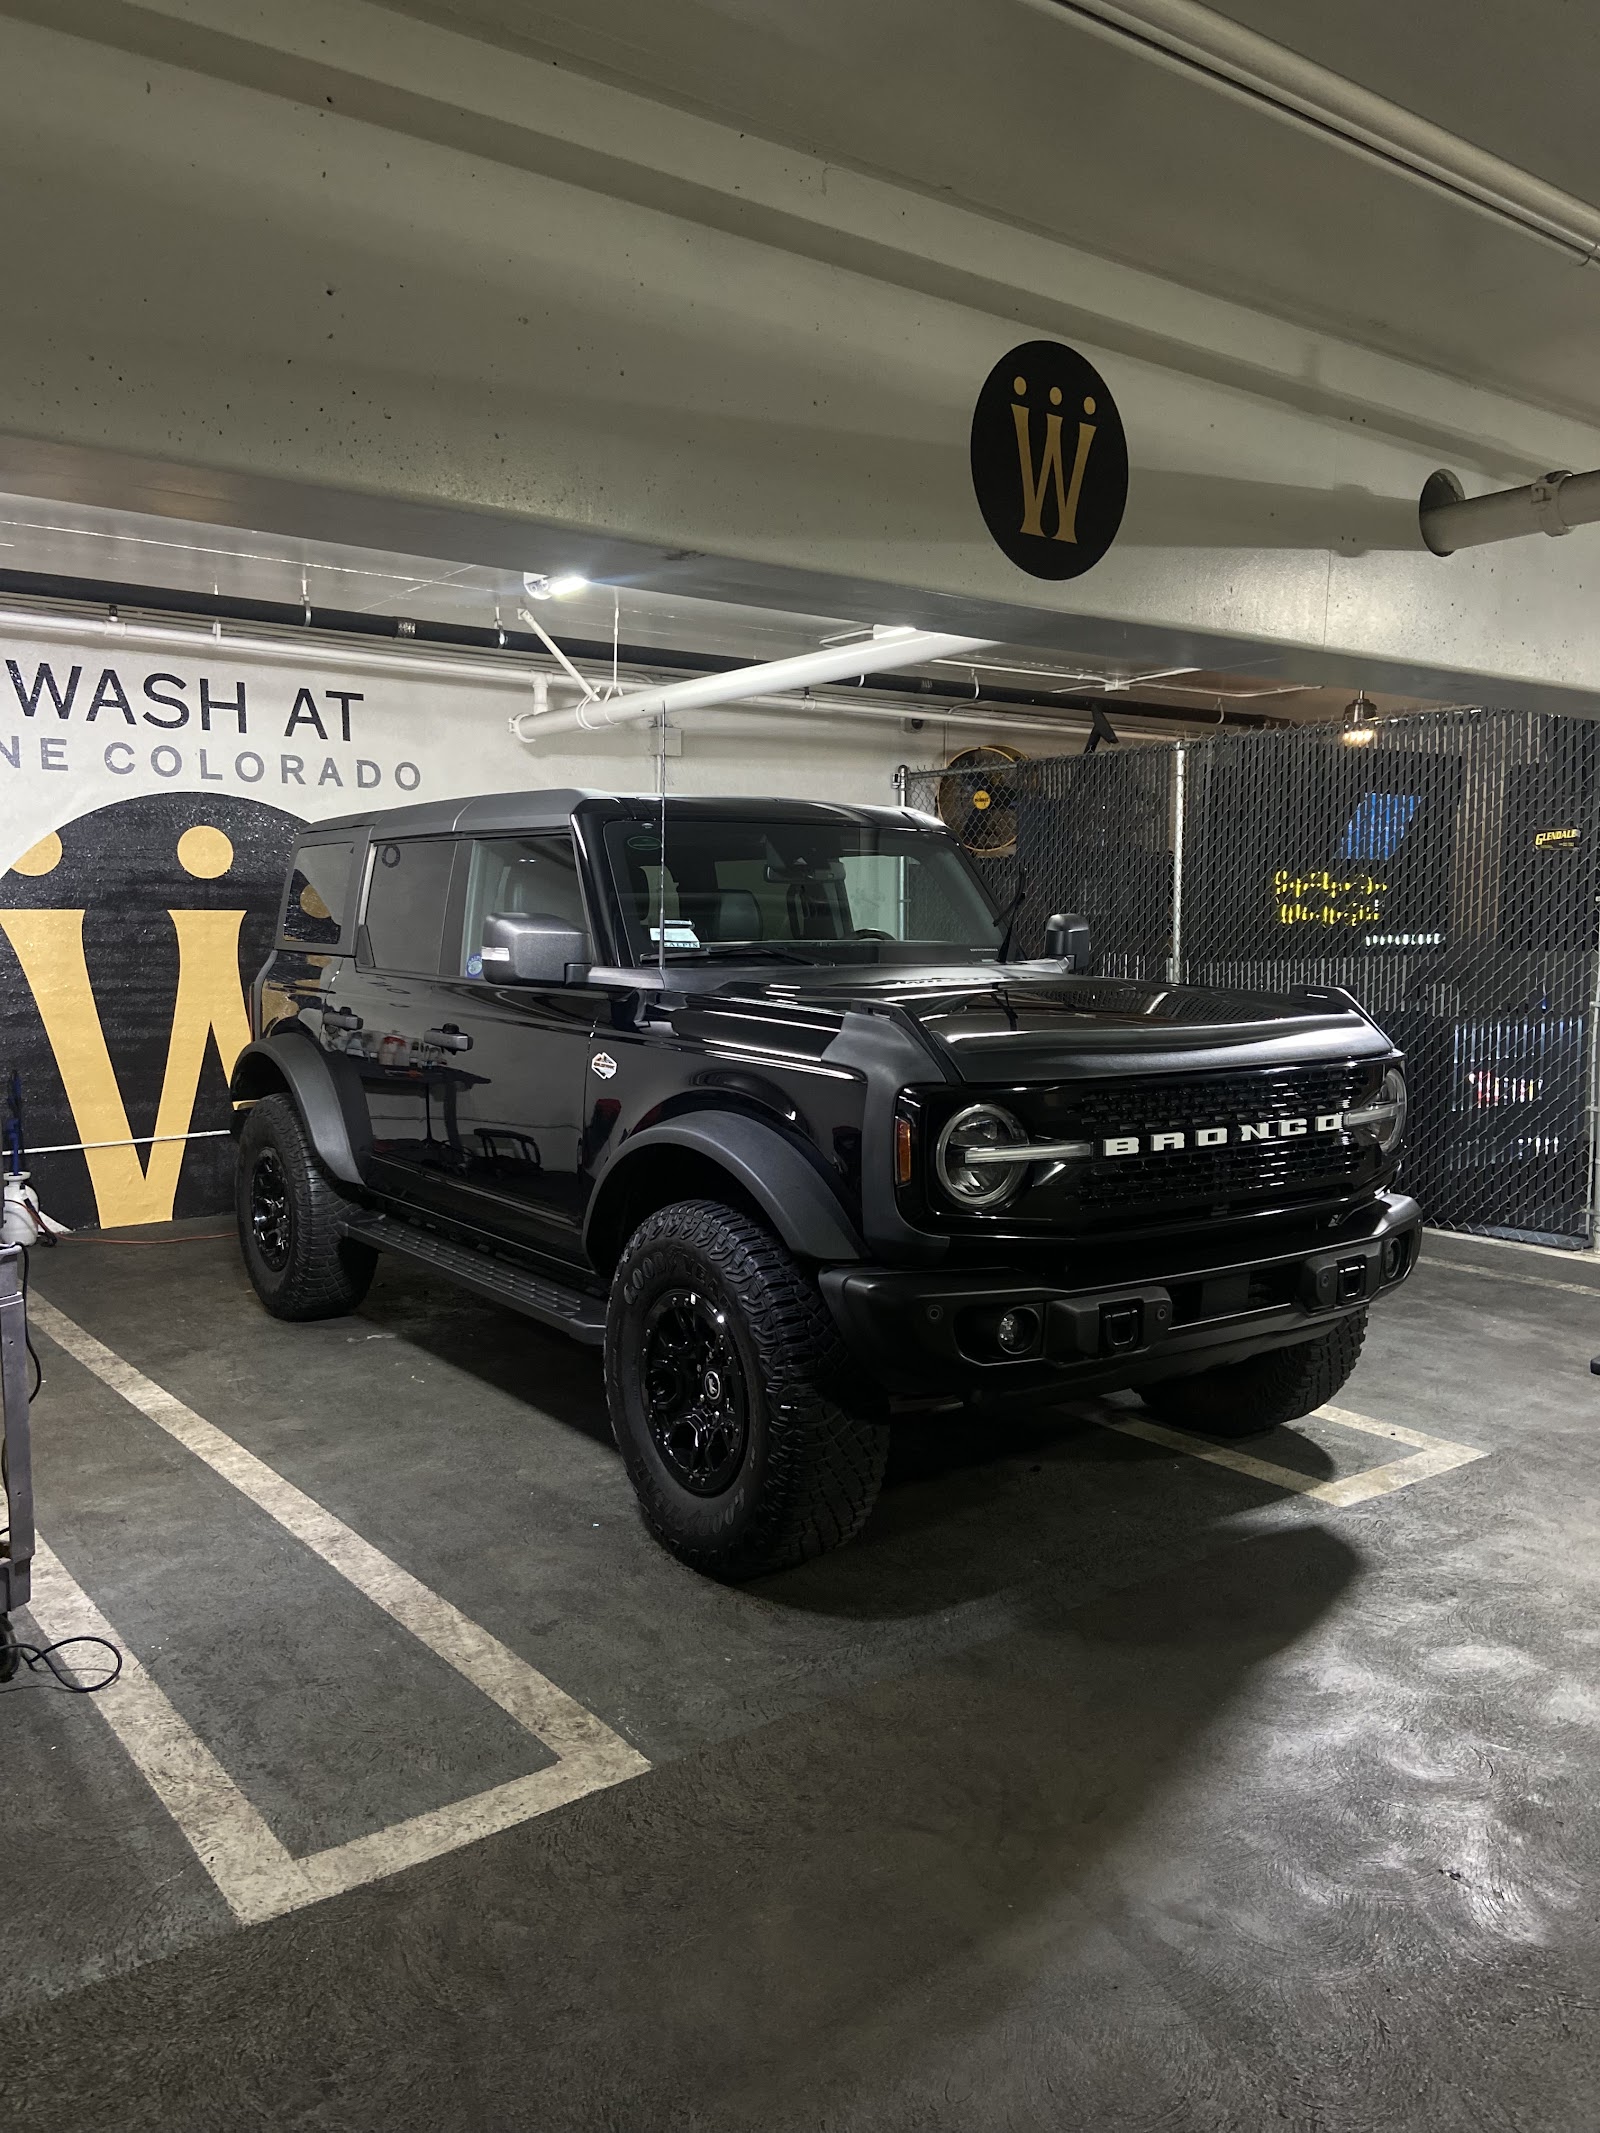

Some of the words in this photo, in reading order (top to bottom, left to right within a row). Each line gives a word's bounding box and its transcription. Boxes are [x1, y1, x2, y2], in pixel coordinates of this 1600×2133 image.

[5, 659, 247, 734] WASH
[284, 687, 364, 741] AT
[104, 741, 421, 791] COLORADO
[1535, 828, 1577, 846] GLENDALE
[1102, 1113, 1342, 1157] BRONCO
[623, 1244, 732, 1308] GOODYEAR
